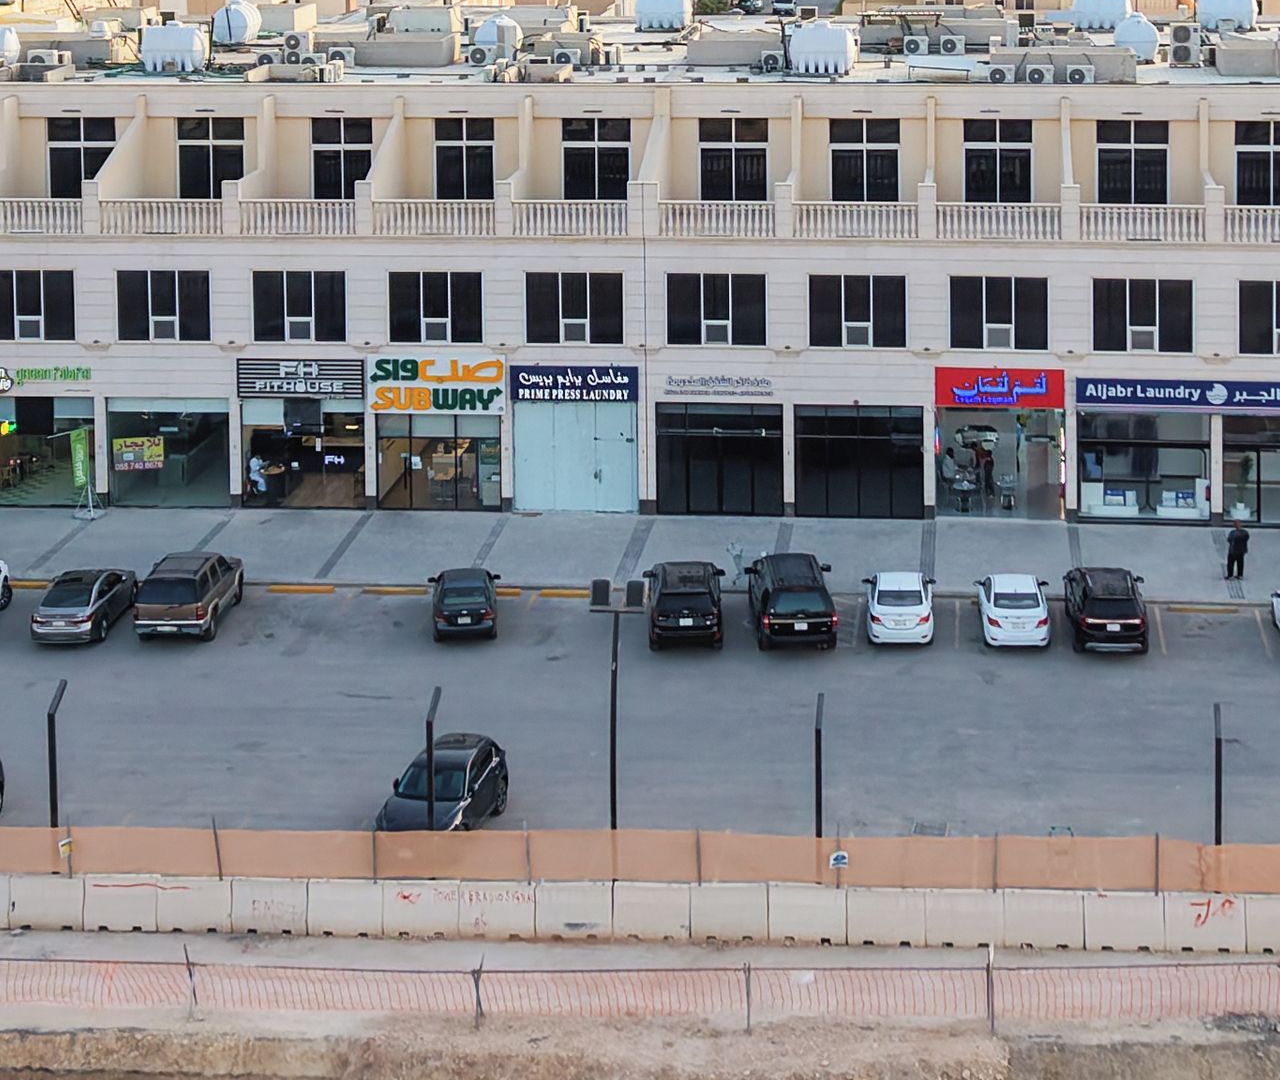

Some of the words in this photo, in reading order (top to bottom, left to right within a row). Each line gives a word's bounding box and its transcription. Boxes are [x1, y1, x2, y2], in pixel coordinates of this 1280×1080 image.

[587, 368, 629, 386] مغاسل
[370, 386, 503, 411] SUBWAY
[518, 388, 550, 399] PRIME
[552, 388, 581, 400] PRESS
[583, 389, 629, 400] LAUNDRY
[1086, 383, 1133, 400] Aljabr
[1136, 384, 1201, 402] Laundry
[1233, 387, 1280, 403] الجبر
